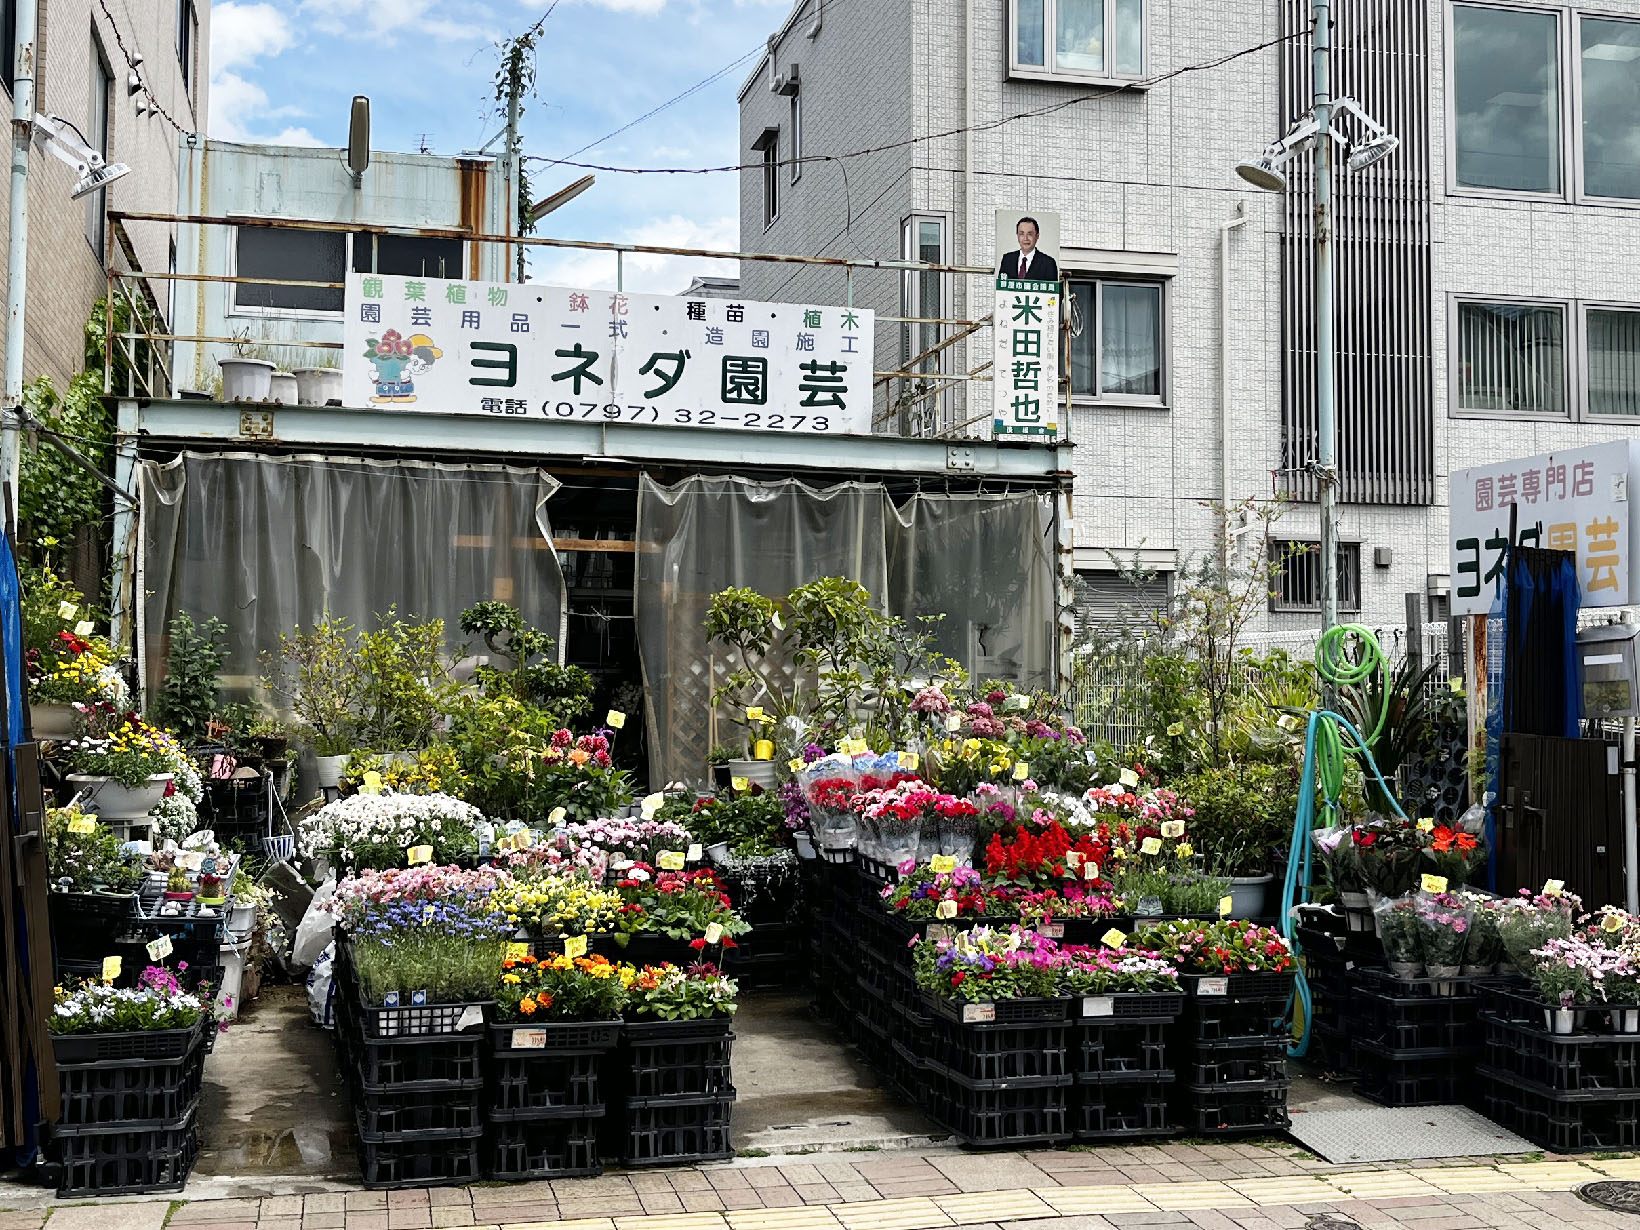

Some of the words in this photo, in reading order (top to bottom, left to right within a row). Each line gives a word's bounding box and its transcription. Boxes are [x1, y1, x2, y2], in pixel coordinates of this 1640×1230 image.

[468, 341, 848, 410] ヨネダ園芸
[1010, 295, 1042, 422] 米田哲也
[480, 397, 528, 415] 電話
[1475, 460, 1594, 512] 園芸専門店
